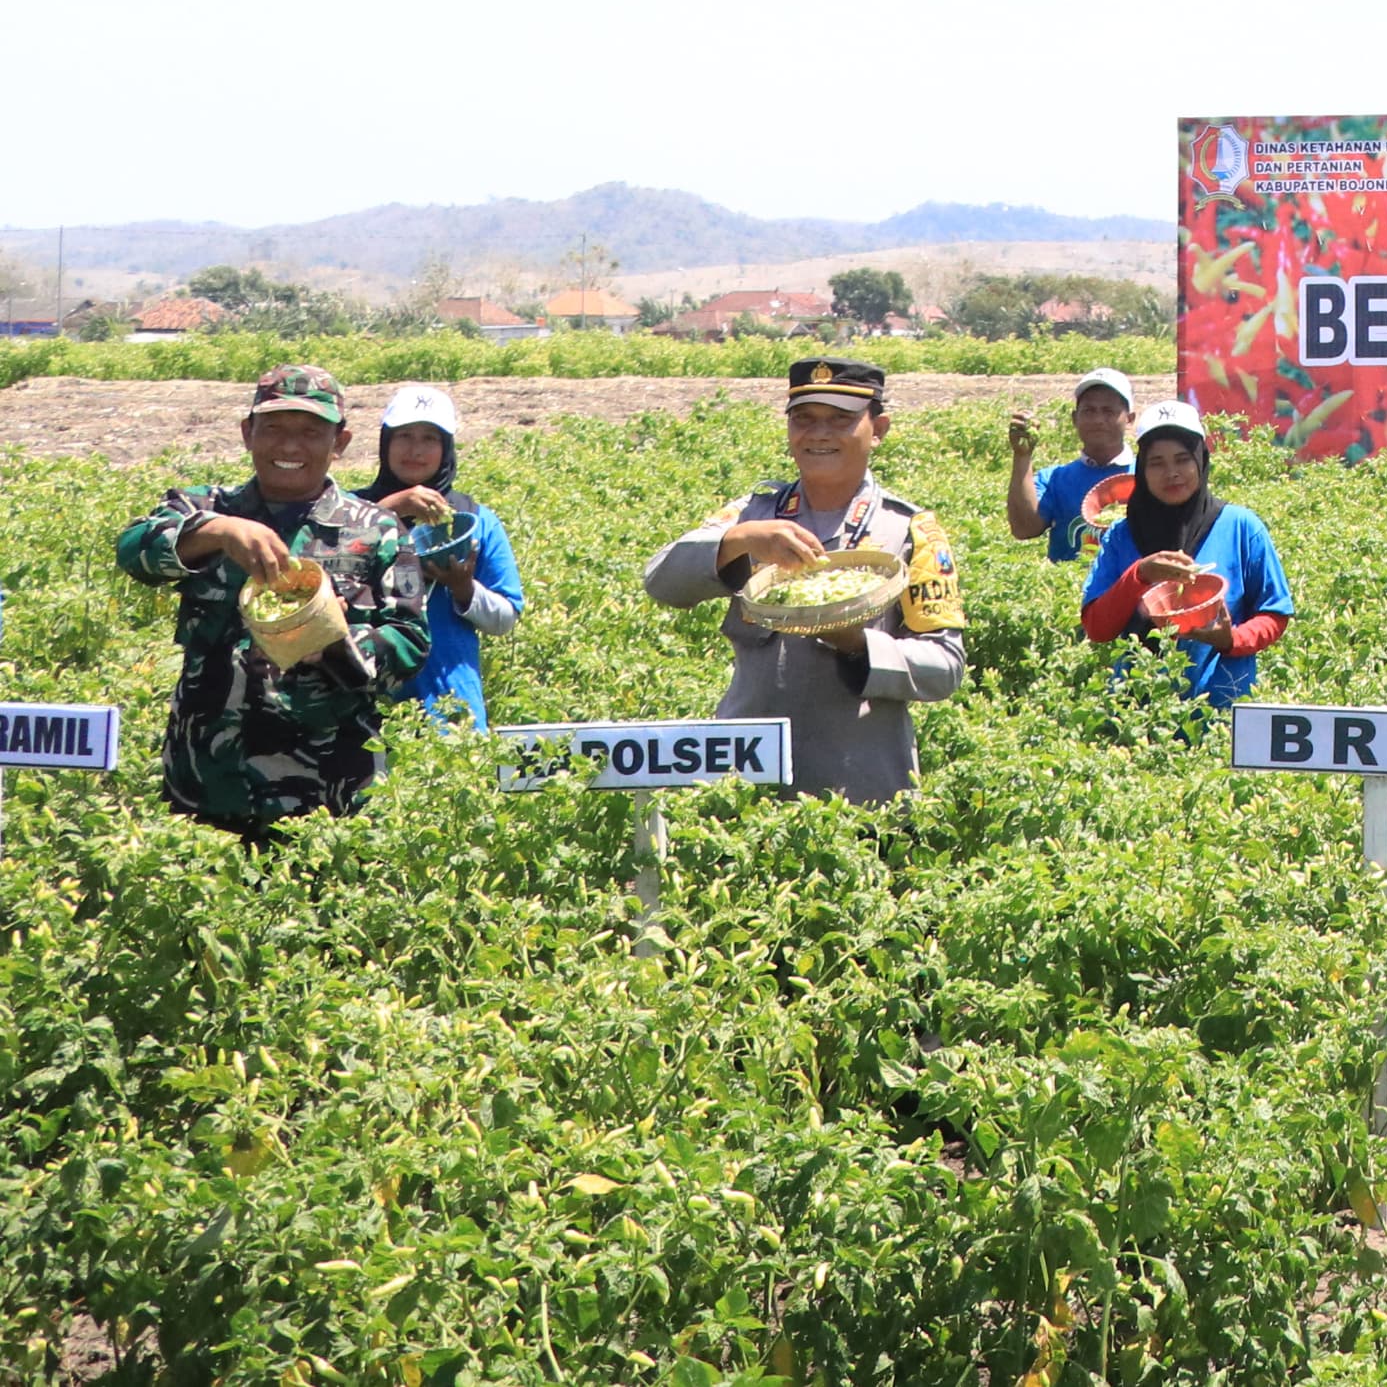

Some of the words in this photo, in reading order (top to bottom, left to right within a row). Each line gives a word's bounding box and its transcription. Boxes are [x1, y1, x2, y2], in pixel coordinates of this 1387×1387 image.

[1255, 143, 1295, 154] DINAS
[1300, 142, 1381, 153] KETAHANAN
[1255, 162, 1283, 173] DAN
[1288, 161, 1362, 173] PERTANIAN
[1255, 181, 1335, 192] KABUPATEN
